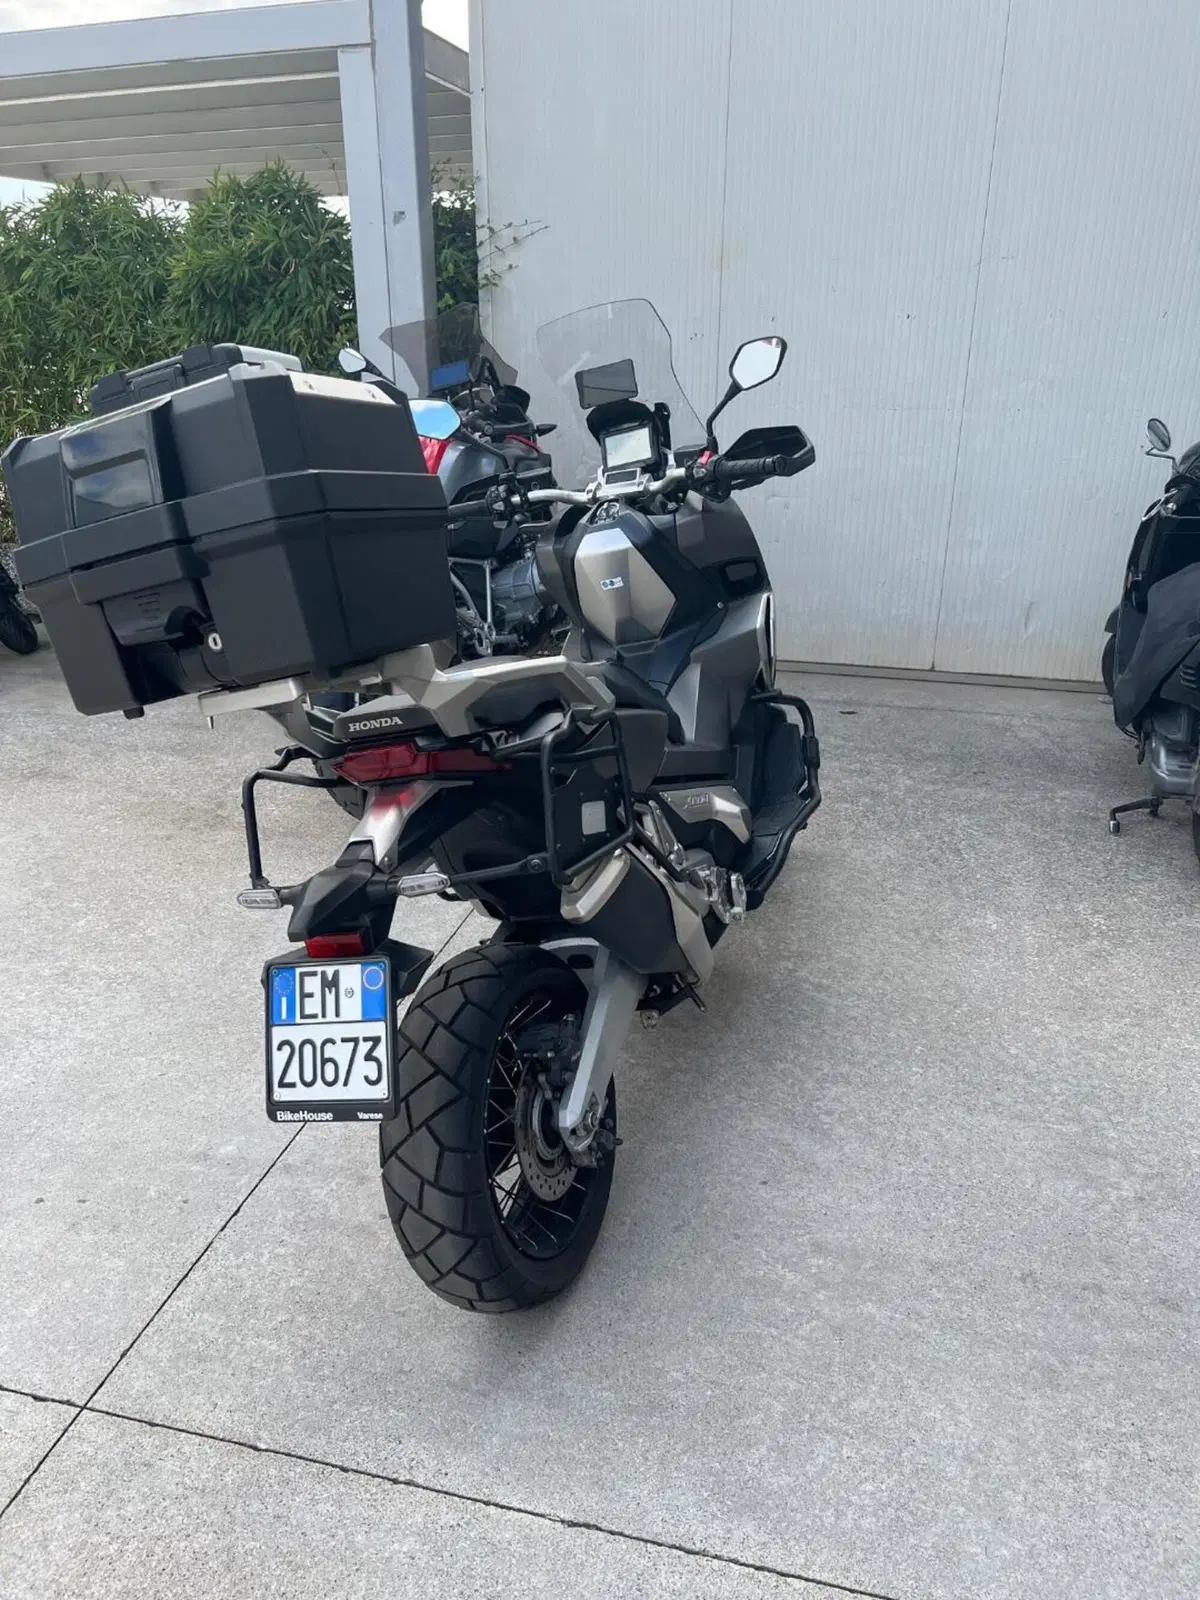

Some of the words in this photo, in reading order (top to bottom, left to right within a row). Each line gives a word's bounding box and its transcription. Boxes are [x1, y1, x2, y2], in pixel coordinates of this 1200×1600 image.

[348, 716, 404, 732] HONDA
[299, 969, 341, 1020] EM
[276, 1035, 383, 1089] 20673
[276, 1110, 334, 1121] BikeHouse
[356, 1111, 384, 1120] Varese
